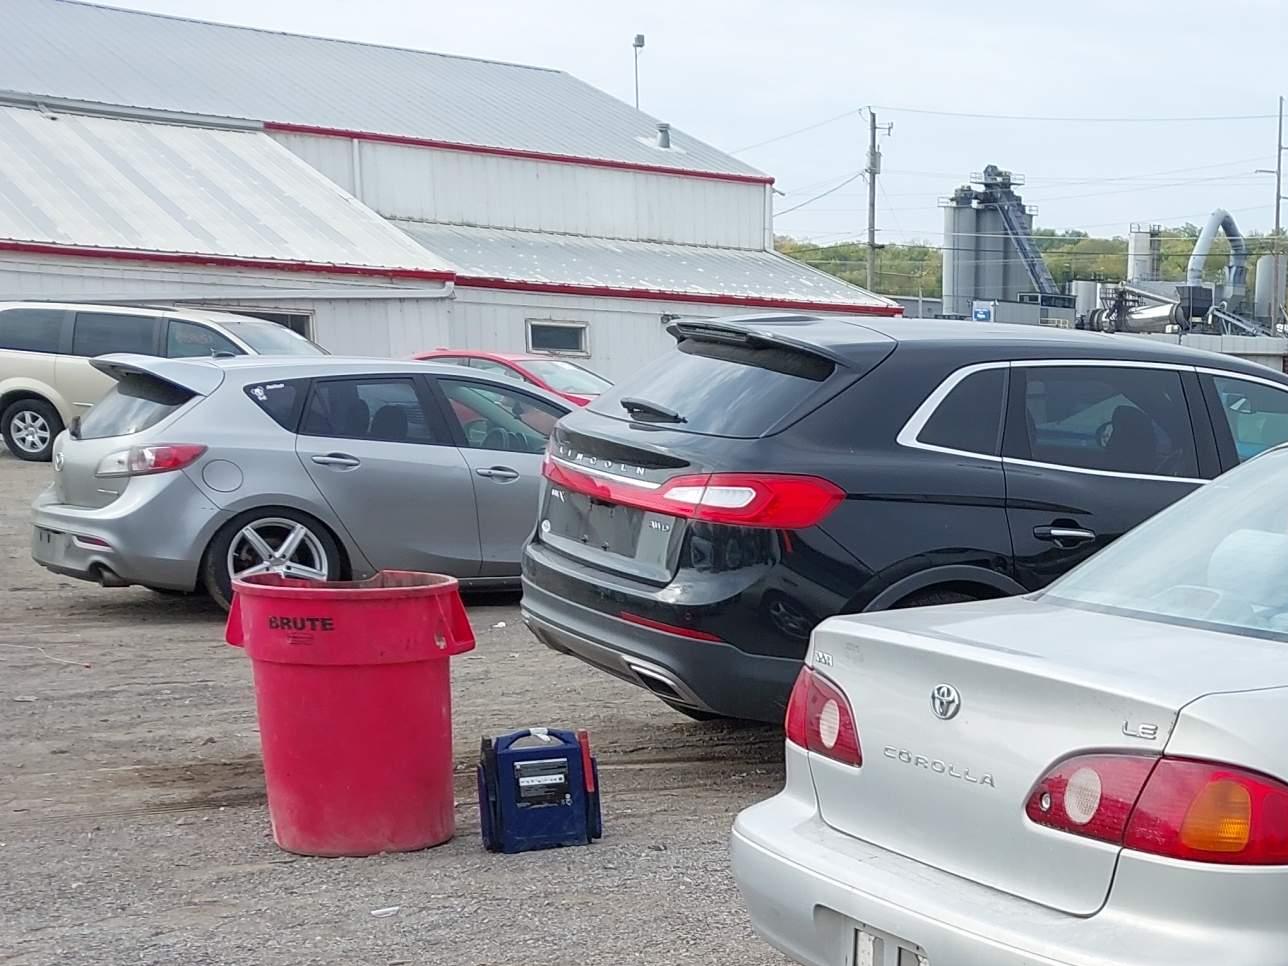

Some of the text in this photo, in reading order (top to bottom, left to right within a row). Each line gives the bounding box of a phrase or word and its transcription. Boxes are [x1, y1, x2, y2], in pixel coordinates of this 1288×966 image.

[559, 446, 645, 475] LINCOLN
[268, 616, 335, 631] BRUTE
[1121, 720, 1159, 740] LE
[883, 745, 995, 788] COROLLA
